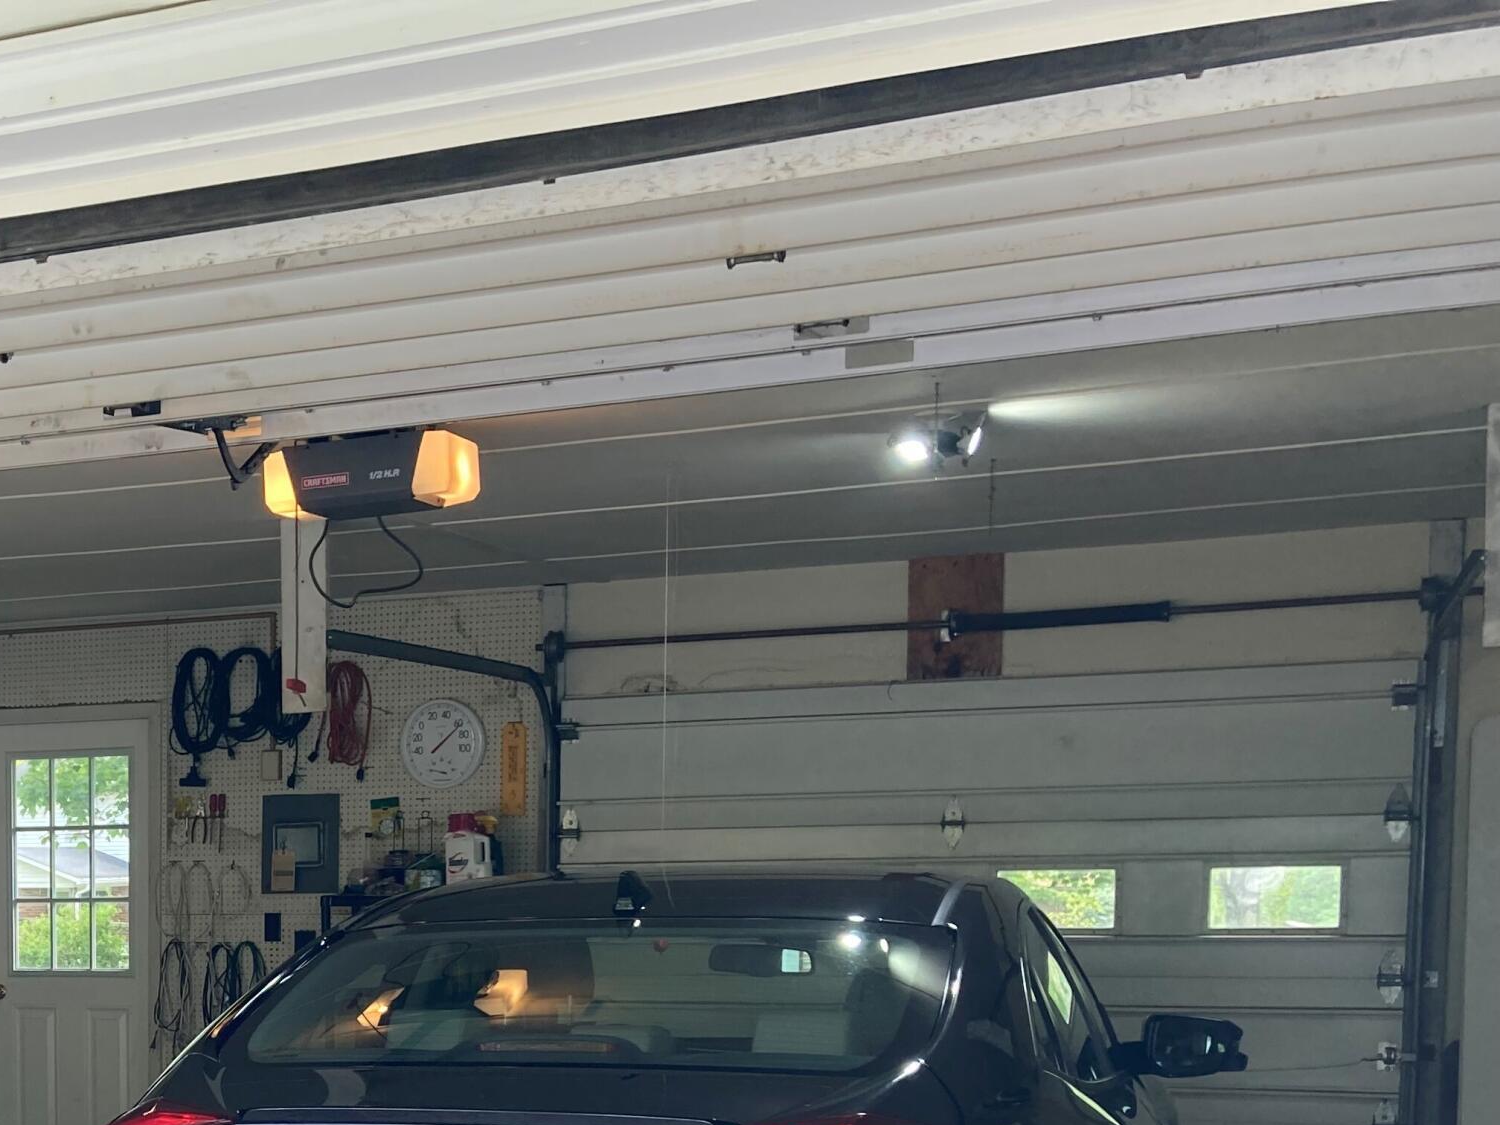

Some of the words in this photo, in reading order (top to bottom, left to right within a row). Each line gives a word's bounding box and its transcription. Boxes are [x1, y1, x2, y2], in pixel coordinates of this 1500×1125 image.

[303, 475, 347, 487] CRAFTSMAN
[428, 711, 438, 720] 20
[441, 710, 451, 719] 40
[458, 743, 471, 753] 100
